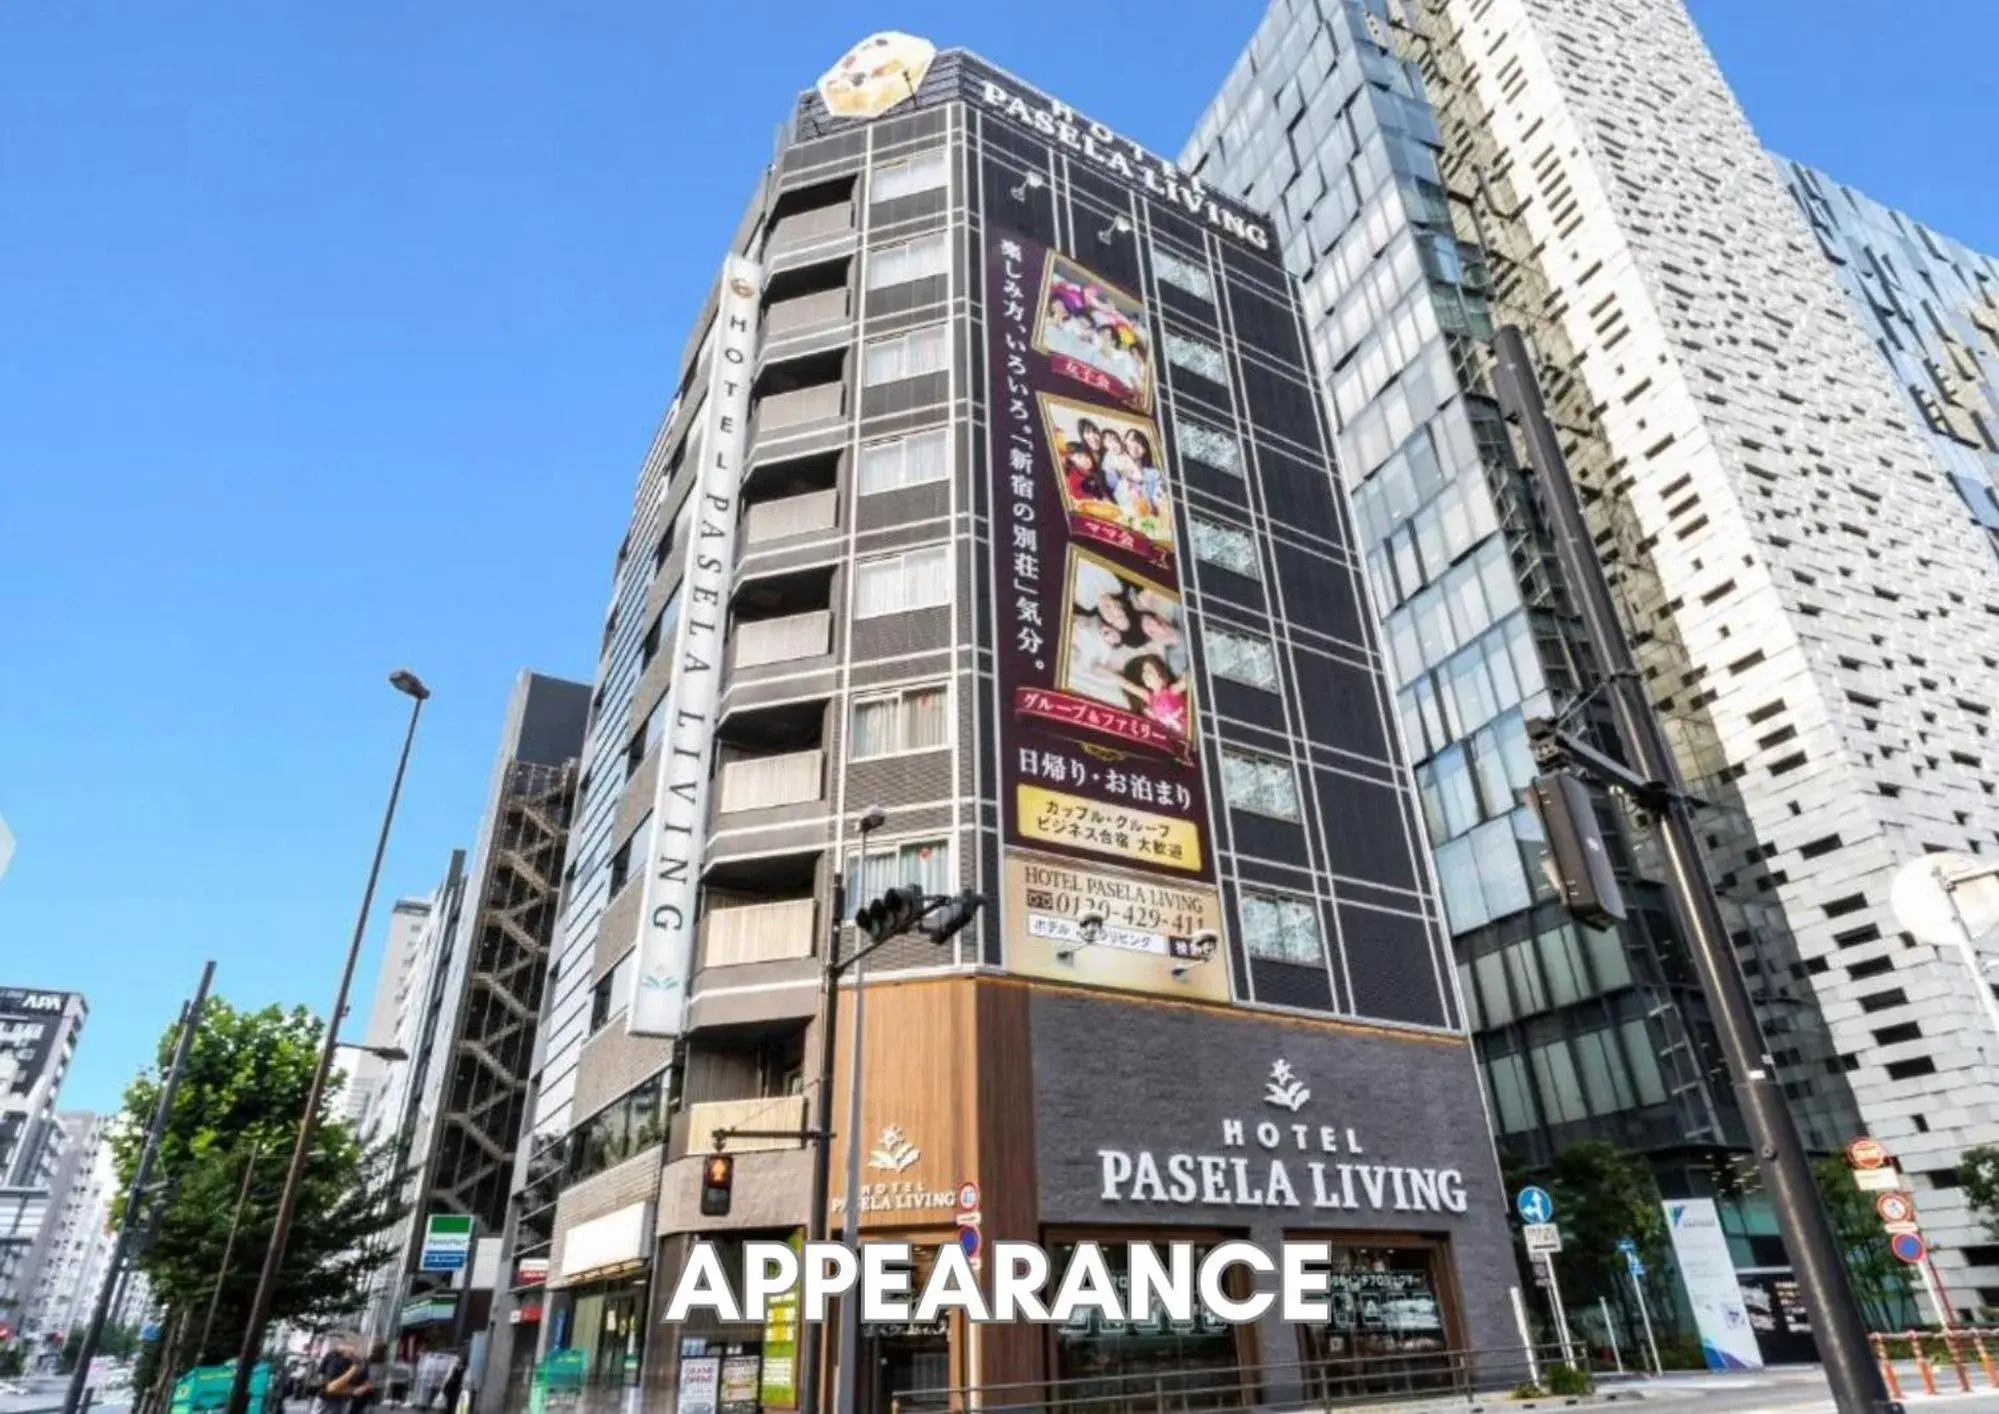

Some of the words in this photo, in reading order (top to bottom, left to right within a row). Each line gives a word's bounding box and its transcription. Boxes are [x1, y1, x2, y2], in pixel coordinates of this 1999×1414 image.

[984, 80, 1133, 178] PASELA
[1139, 166, 1268, 249] LIVING
[715, 314, 748, 471] HOTEL
[683, 492, 730, 673] PASELA
[1019, 747, 1191, 811] 日帰り・お泊まり
[652, 708, 705, 932] LIVING
[1025, 866, 1083, 891] HOTEL
[1087, 878, 1147, 904] PASELA
[1150, 887, 1204, 914] LIVING
[1221, 1118, 1364, 1154] HOTEL
[831, 1194, 892, 1213] PELA
[896, 1190, 955, 1209] LIVING
[860, 1181, 926, 1196] HOTEL
[1098, 1149, 1300, 1207] PASELA
[1308, 1161, 1468, 1213] LIVING
